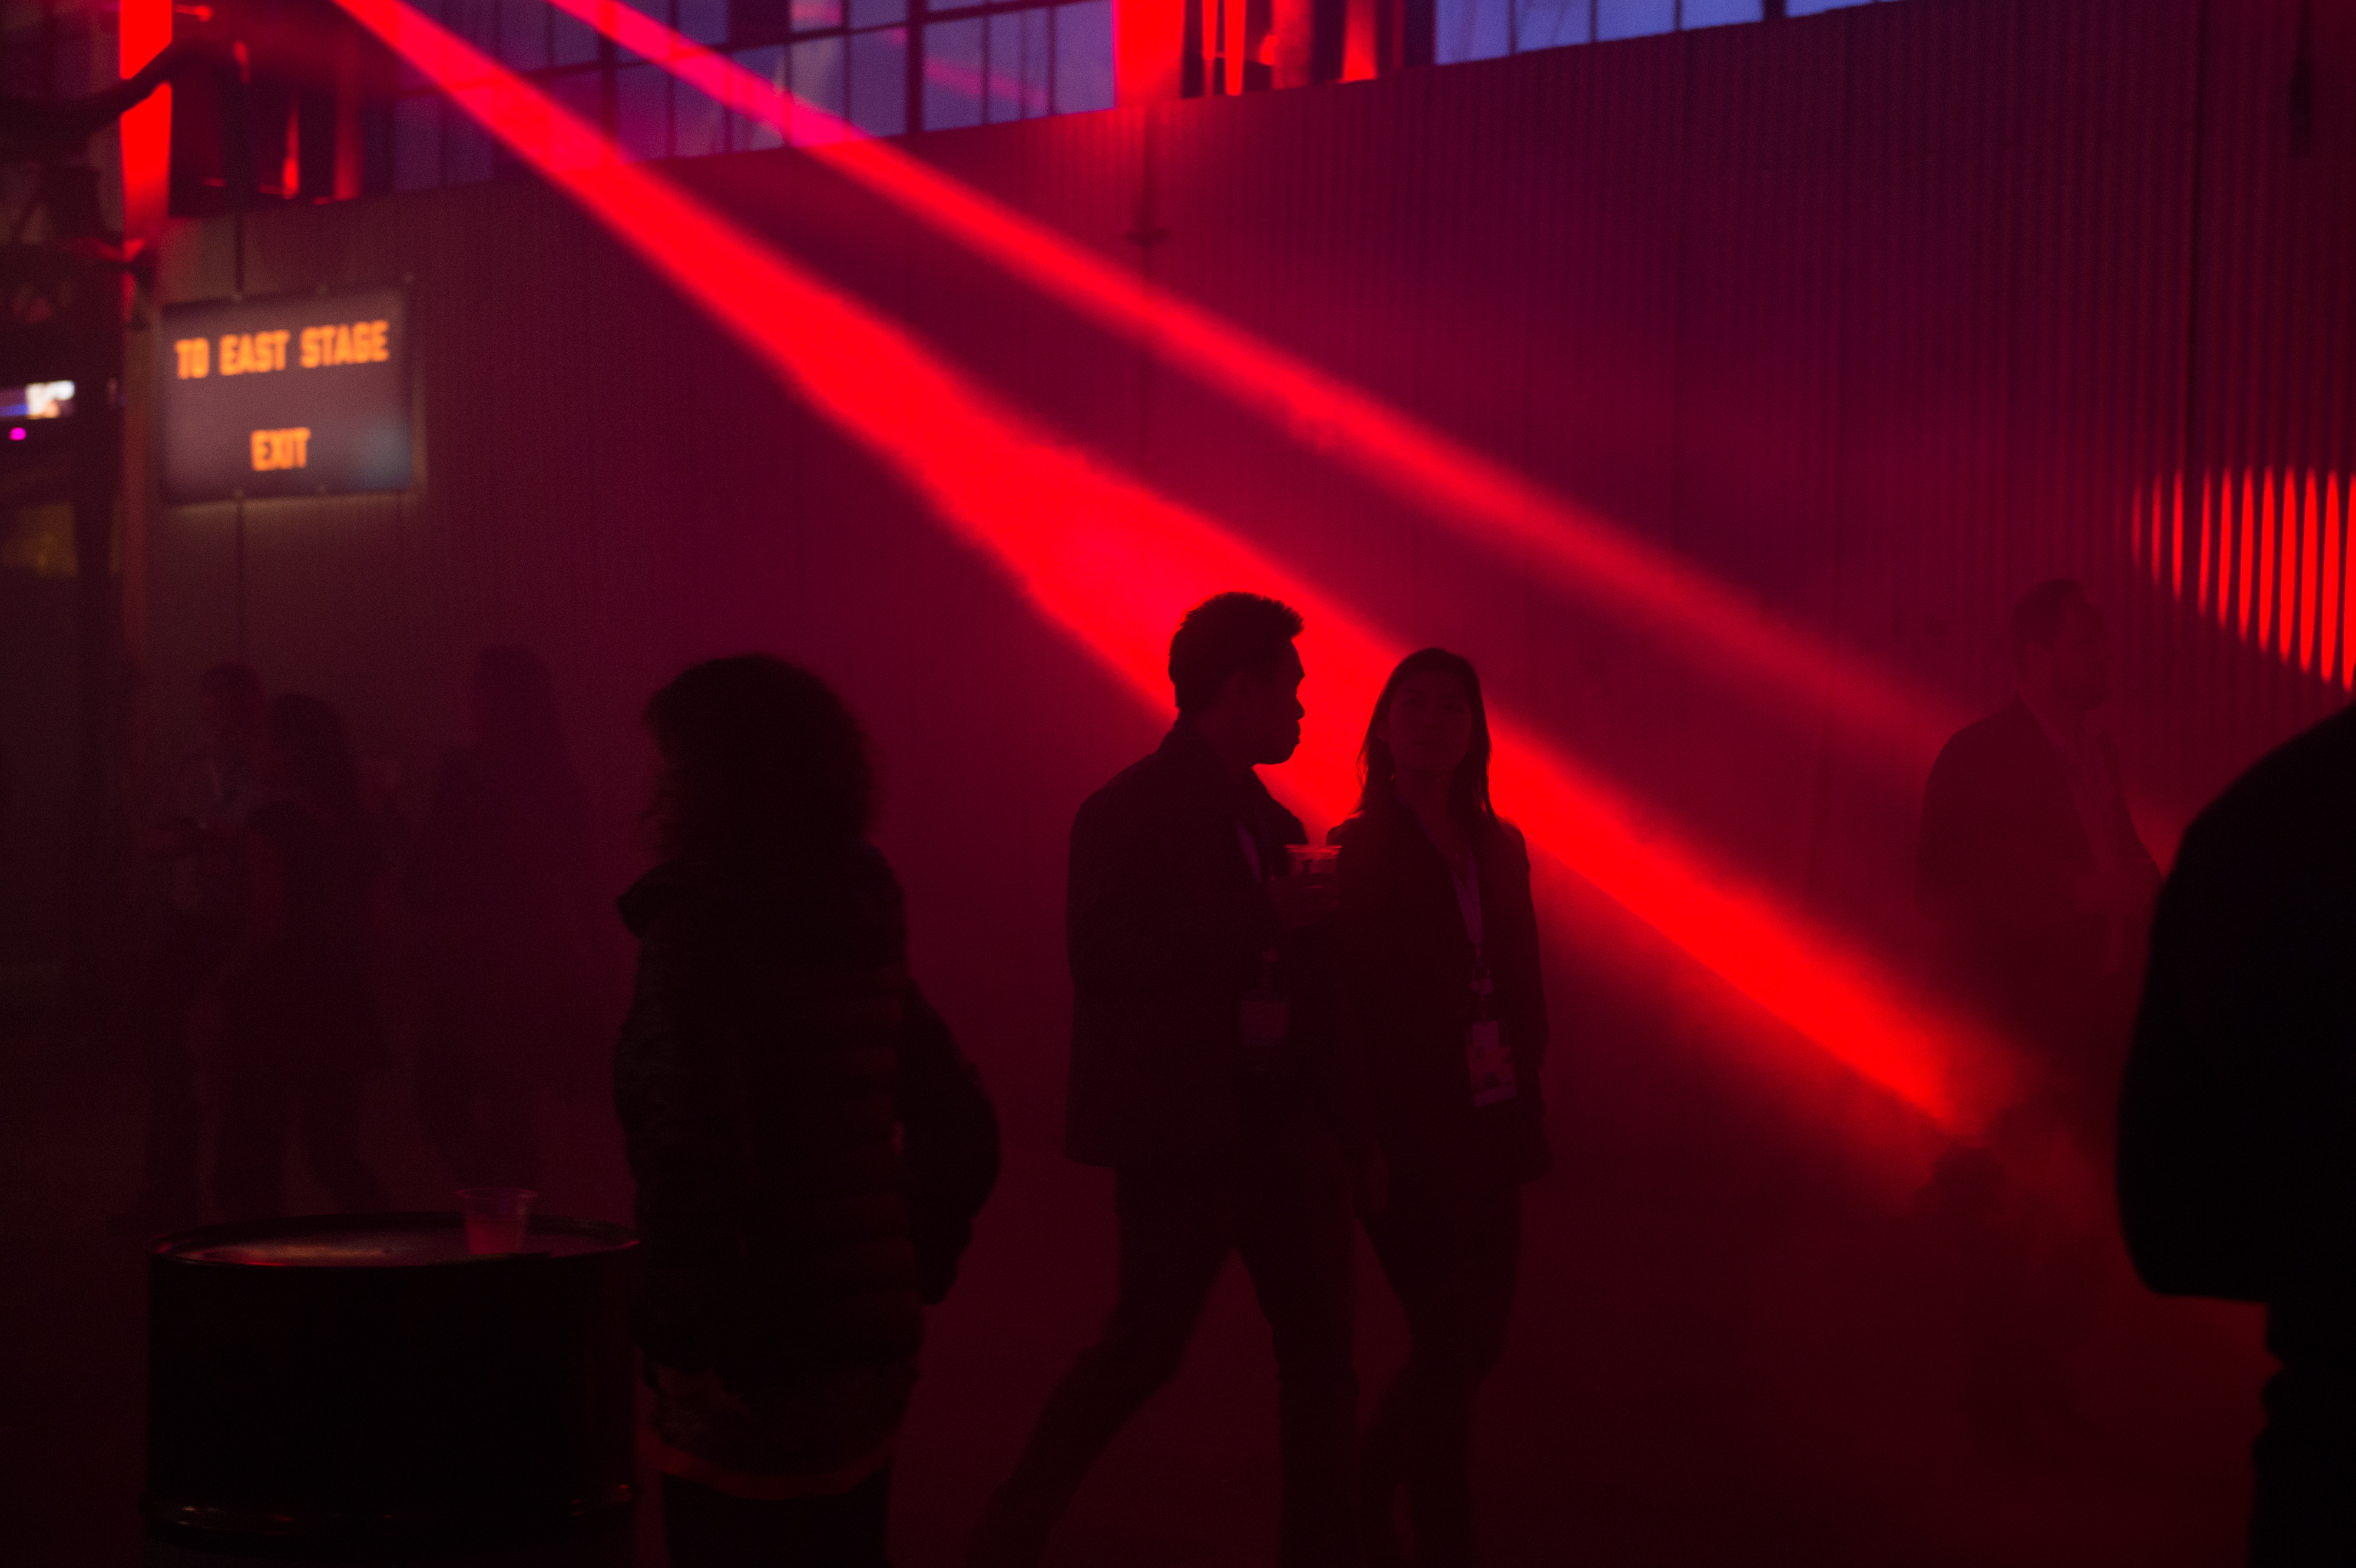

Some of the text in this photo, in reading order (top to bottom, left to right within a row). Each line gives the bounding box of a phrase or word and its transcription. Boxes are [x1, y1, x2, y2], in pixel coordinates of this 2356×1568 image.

[174, 319, 389, 380] TO EAST STAGE
[250, 426, 311, 472] EXIT
